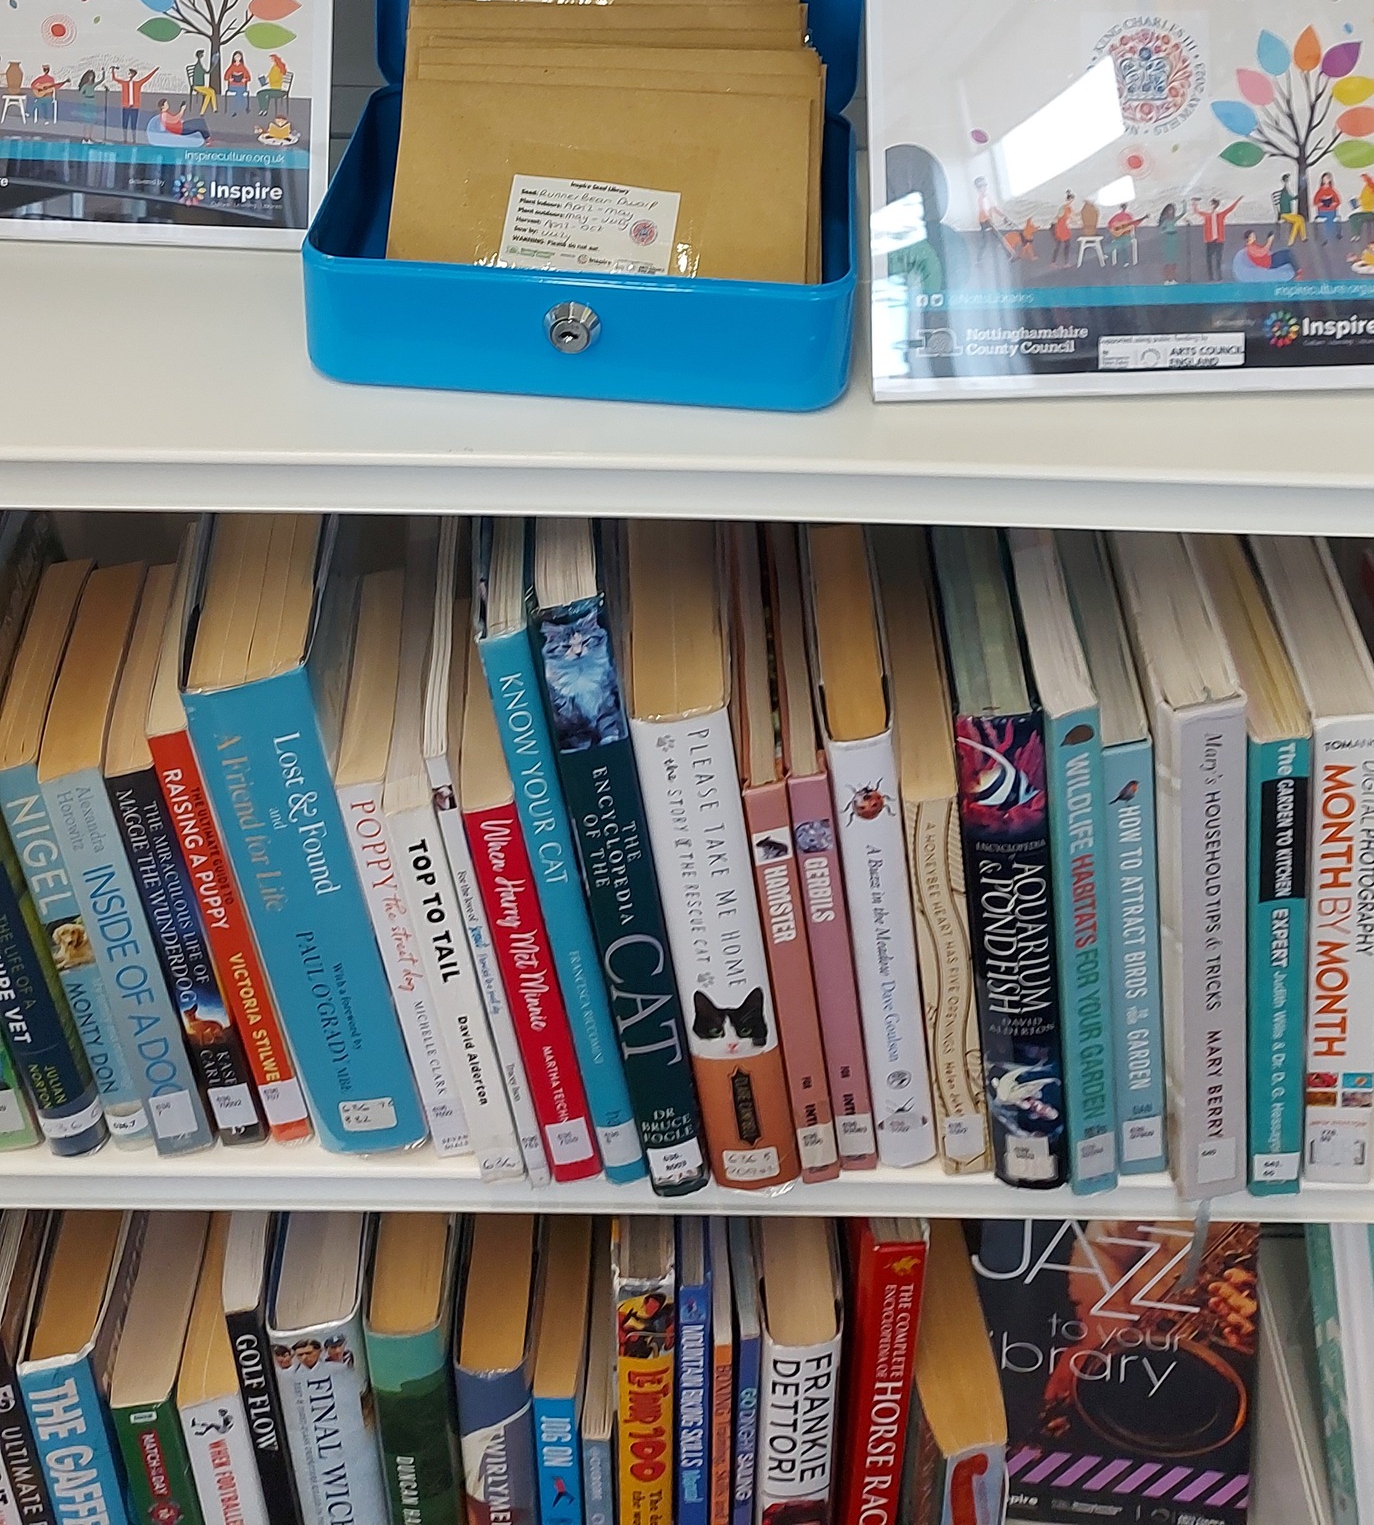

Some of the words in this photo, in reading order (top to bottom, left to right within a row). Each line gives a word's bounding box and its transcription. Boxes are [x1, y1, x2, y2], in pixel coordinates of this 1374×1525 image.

[210, 181, 283, 201] Inspire
[966, 325, 1089, 342] Nottinghamshire
[966, 342, 1018, 357] County
[1020, 339, 1075, 354] Council
[1302, 315, 1374, 339] Inspire
[272, 731, 305, 788] Lost
[500, 672, 539, 756] KNOW
[520, 760, 556, 836] YOUR
[538, 842, 569, 884] CAT
[687, 727, 721, 814] PLEASE
[1277, 743, 1297, 776] The
[115, 788, 150, 855] MAGGIE
[288, 791, 318, 823] &
[583, 814, 600, 839] OF
[1065, 752, 1094, 856] WILDLIFE
[1118, 804, 1142, 844] HOW
[1275, 778, 1295, 828] GARDEN
[1319, 765, 1357, 890] MONTH
[6, 795, 73, 916] NIGEL
[162, 768, 203, 849] RAISING
[189, 854, 205, 868] A
[198, 870, 230, 931] PUPPY
[299, 821, 342, 897] Found
[350, 799, 398, 891] POPPY
[407, 838, 438, 884] TOP
[480, 818, 514, 872] When
[592, 765, 635, 926] ENCYCLOPEDIA
[622, 820, 642, 864] THE
[704, 821, 731, 879] TAKE
[1119, 846, 1143, 871] TO
[1204, 789, 1222, 897] HOUSEHOLD
[1275, 828, 1293, 847] TO
[137, 852, 161, 889] THE
[590, 847, 610, 888] THE
[802, 856, 836, 924] GERBILS
[1275, 848, 1293, 898] KITCHEN
[422, 892, 447, 923] TO
[715, 888, 738, 920] ME
[763, 864, 797, 946] HAMSTER
[1071, 853, 1098, 950] HABITATS
[1120, 875, 1146, 946] ATTRACT
[1205, 898, 1222, 934] TIPS
[1316, 896, 1352, 935] BY
[83, 862, 139, 962] INSIDE
[116, 965, 157, 1008] OF
[148, 890, 197, 1005] WUNDERDOG
[432, 926, 461, 985] TAIL
[509, 928, 540, 970] Met
[720, 929, 748, 988] HOME
[1011, 860, 1052, 1014] AQUARIUM
[1270, 908, 1290, 968] EXPERT
[228, 952, 262, 1025] VICTORIA
[880, 979, 897, 1012] Dave
[1075, 948, 1100, 990] FOR
[1124, 950, 1148, 1000] BIRDS
[1206, 954, 1222, 1012] TRICKS
[1313, 940, 1350, 1057] MONTH
[518, 969, 550, 1033] Minnie
[603, 933, 682, 1066] CAT
[1077, 990, 1102, 1048] YOUR
[457, 1016, 476, 1048] David
[467, 1053, 488, 1106] Alderton
[881, 1012, 901, 1062] Goulson
[1126, 1028, 1152, 1091] GARDEN
[1206, 1030, 1223, 1078] MARY
[1079, 1046, 1106, 1122] GARDEN
[1207, 1084, 1224, 1139] BERRY
[971, 1219, 1200, 1322] JAZZ
[1048, 1312, 1088, 1341] to
[1097, 1326, 1187, 1352] your
[235, 1333, 265, 1394] GOLF
[1001, 1331, 1178, 1398] brary
[28, 1377, 87, 1441] THE
[248, 1392, 279, 1452] FLOW
[306, 1375, 338, 1460] FINAL
[540, 1415, 572, 1444] JOG
[767, 1357, 801, 1485] DETTORI
[799, 1351, 833, 1483] FRANKIE
[865, 1381, 904, 1469] HORSE
[541, 1445, 573, 1468] ON
